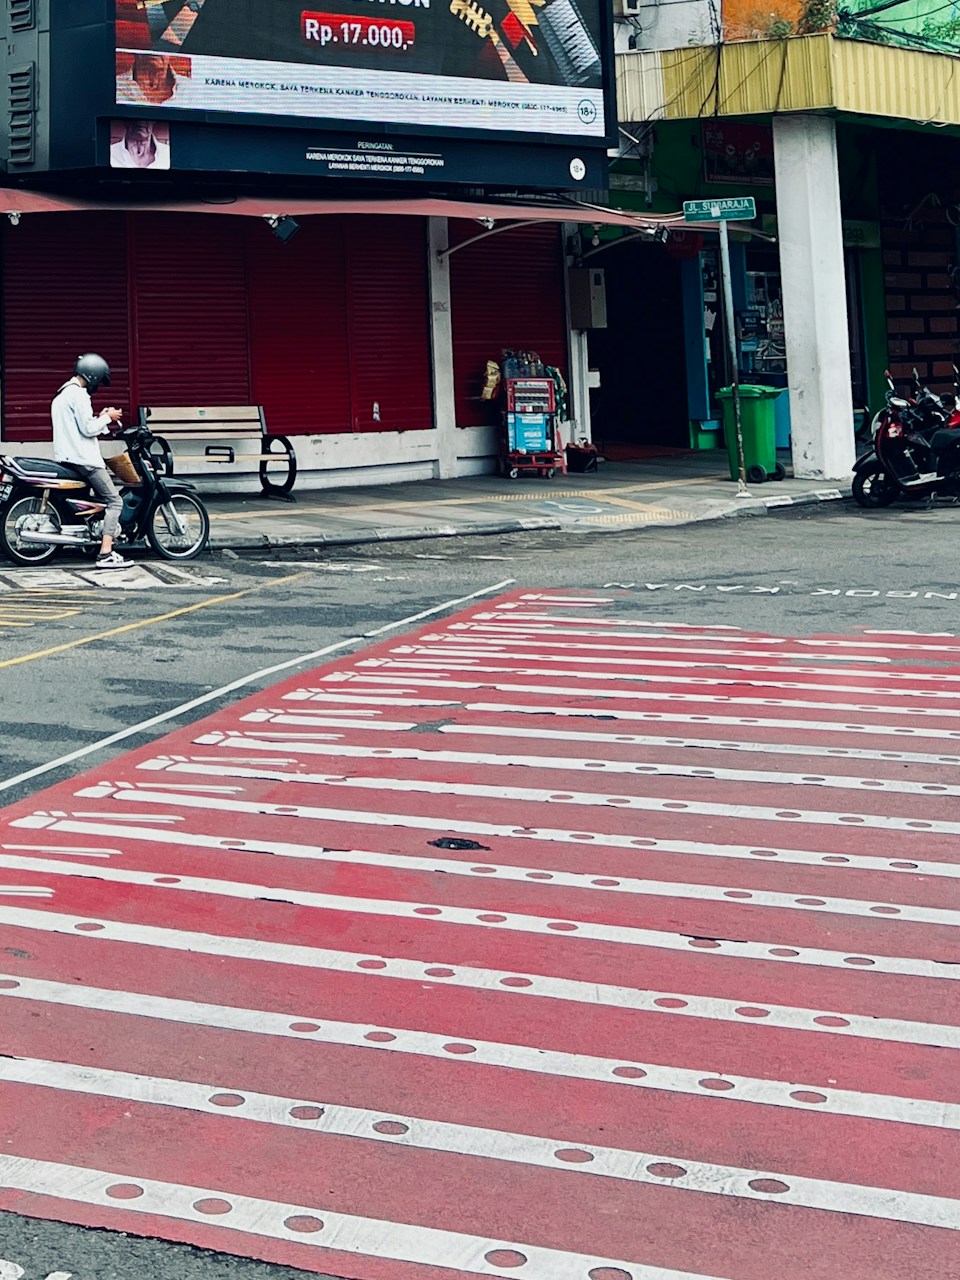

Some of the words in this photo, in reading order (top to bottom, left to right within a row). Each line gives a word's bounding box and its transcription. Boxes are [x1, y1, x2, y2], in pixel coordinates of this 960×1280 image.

[204, 78, 236, 87] KARENA
[280, 83, 298, 92] SAYA
[300, 85, 333, 95] TERKENA
[335, 87, 364, 96] KANKER
[422, 95, 452, 104] LAYANAN
[488, 100, 520, 109] MEROKOK
[580, 106, 594, 117] 18+
